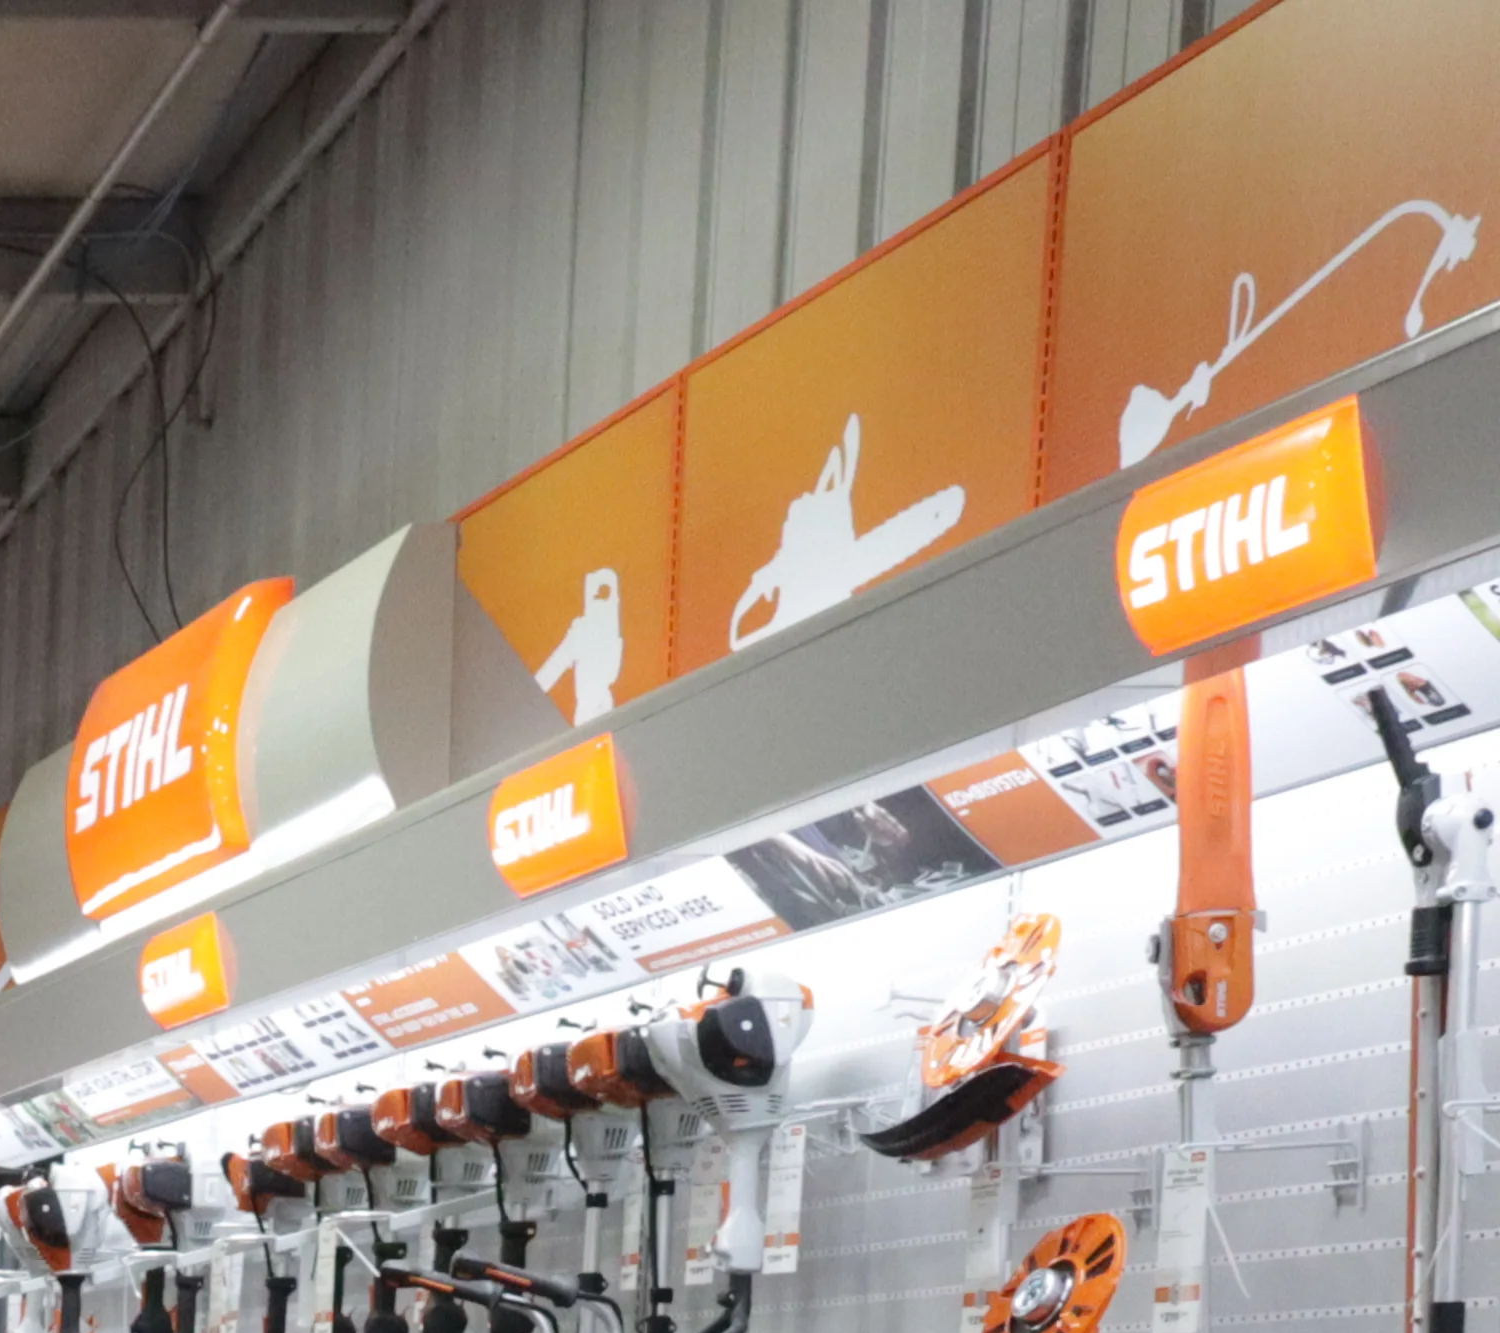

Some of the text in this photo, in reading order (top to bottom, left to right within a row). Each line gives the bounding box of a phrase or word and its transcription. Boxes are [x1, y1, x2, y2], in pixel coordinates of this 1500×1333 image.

[1128, 474, 1310, 610] STIHL
[75, 682, 193, 834] STIHL
[491, 783, 592, 866] STIHL
[592, 884, 664, 920] SOLD AND
[611, 907, 680, 941] SERVICED
[142, 948, 205, 1013] STIHL
